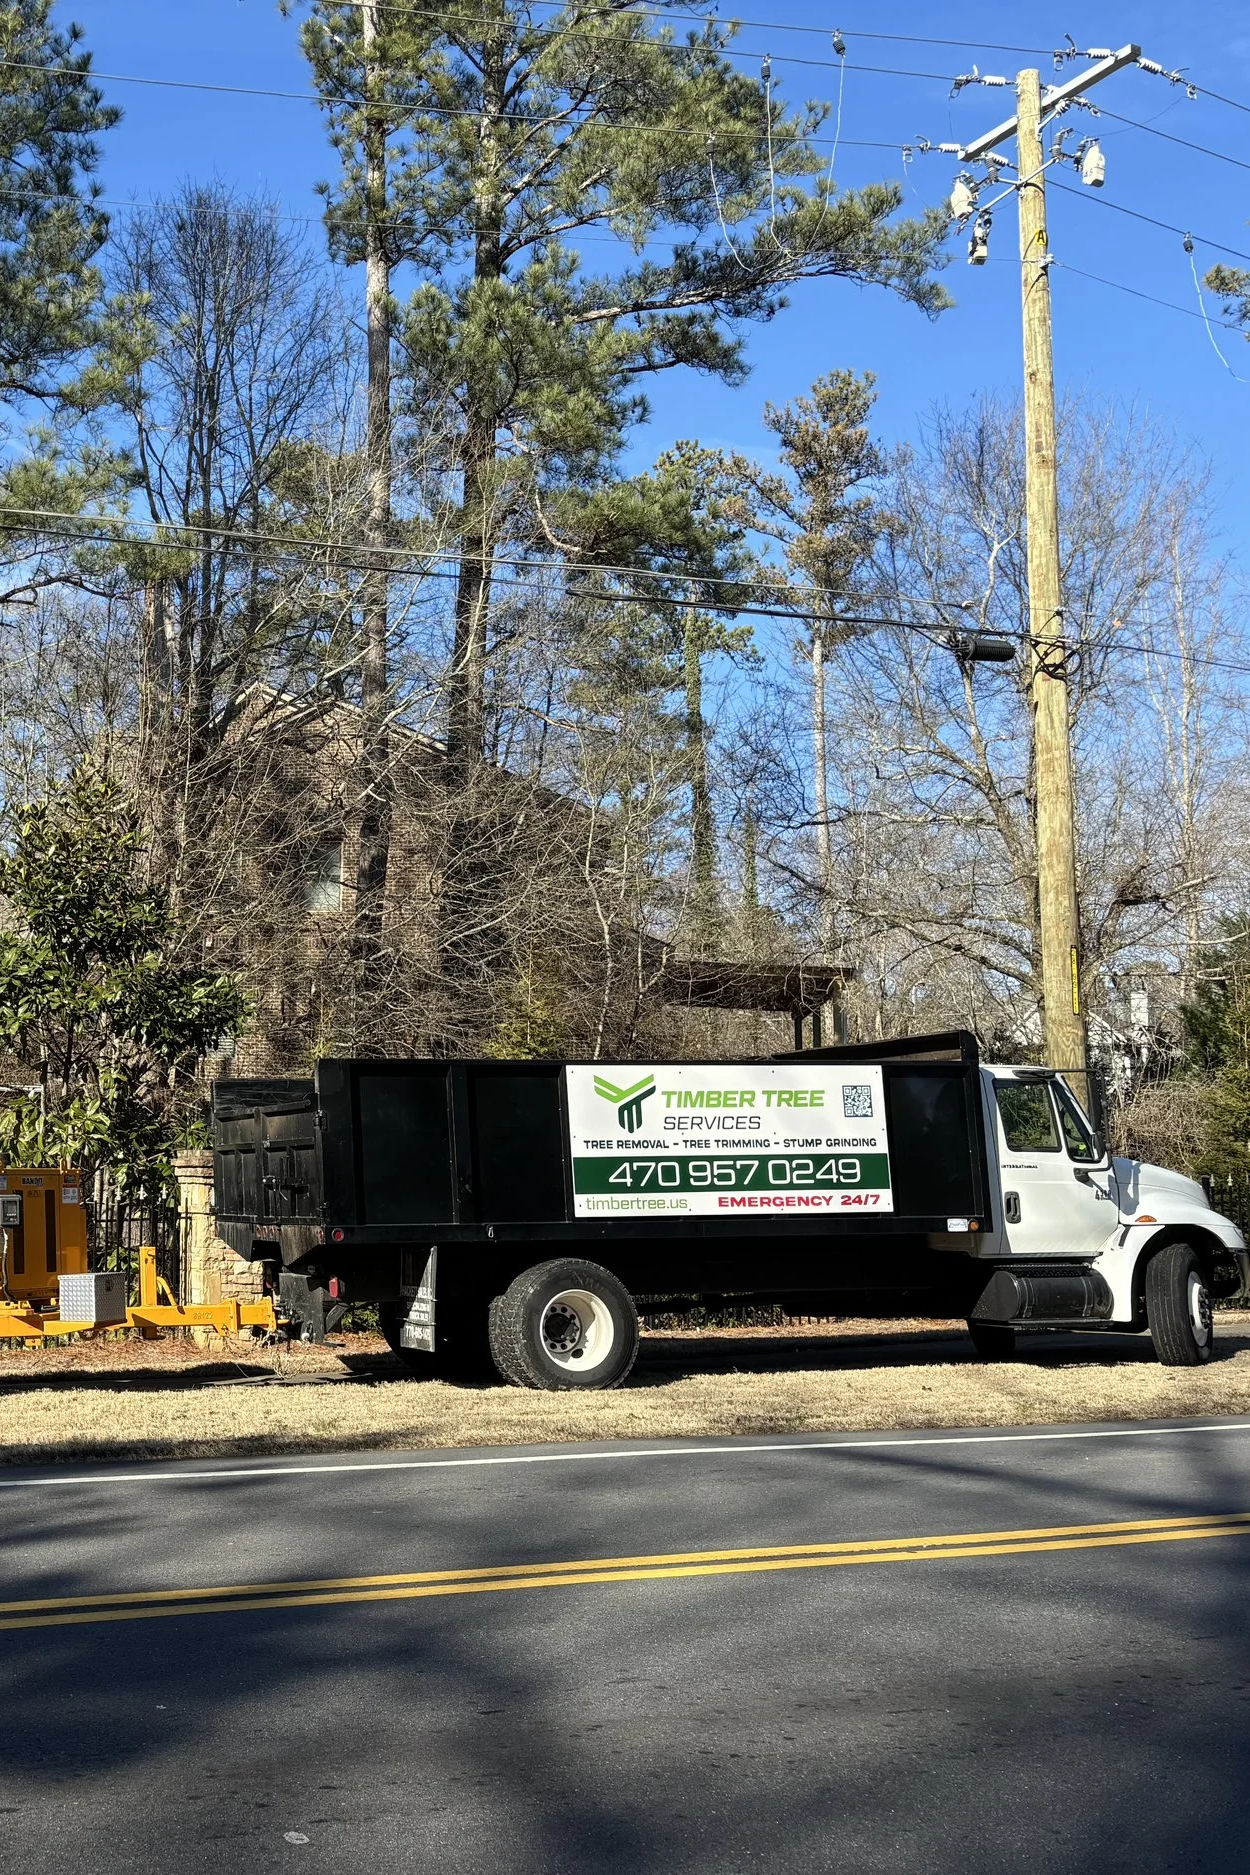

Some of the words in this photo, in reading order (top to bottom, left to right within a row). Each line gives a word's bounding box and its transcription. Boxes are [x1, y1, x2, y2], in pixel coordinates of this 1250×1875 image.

[1037, 229, 1046, 244] A
[661, 1090, 755, 1108] TIMBER
[762, 1089, 826, 1108] TREE
[663, 1116, 761, 1131] SERVICES
[583, 1140, 614, 1149] TREE
[616, 1139, 670, 1149] REMOVAL
[682, 1139, 712, 1148] TREE
[714, 1139, 771, 1148] TRIMMING
[783, 1138, 823, 1148] STUMP
[825, 1138, 878, 1147] GRINDING
[608, 1162, 680, 1187] 470
[689, 1160, 760, 1186] 957
[767, 1158, 862, 1184] 0249
[586, 1196, 689, 1211] timbertree.us
[718, 1195, 834, 1208] EMERGENCY
[840, 1194, 881, 1206] 24/7
